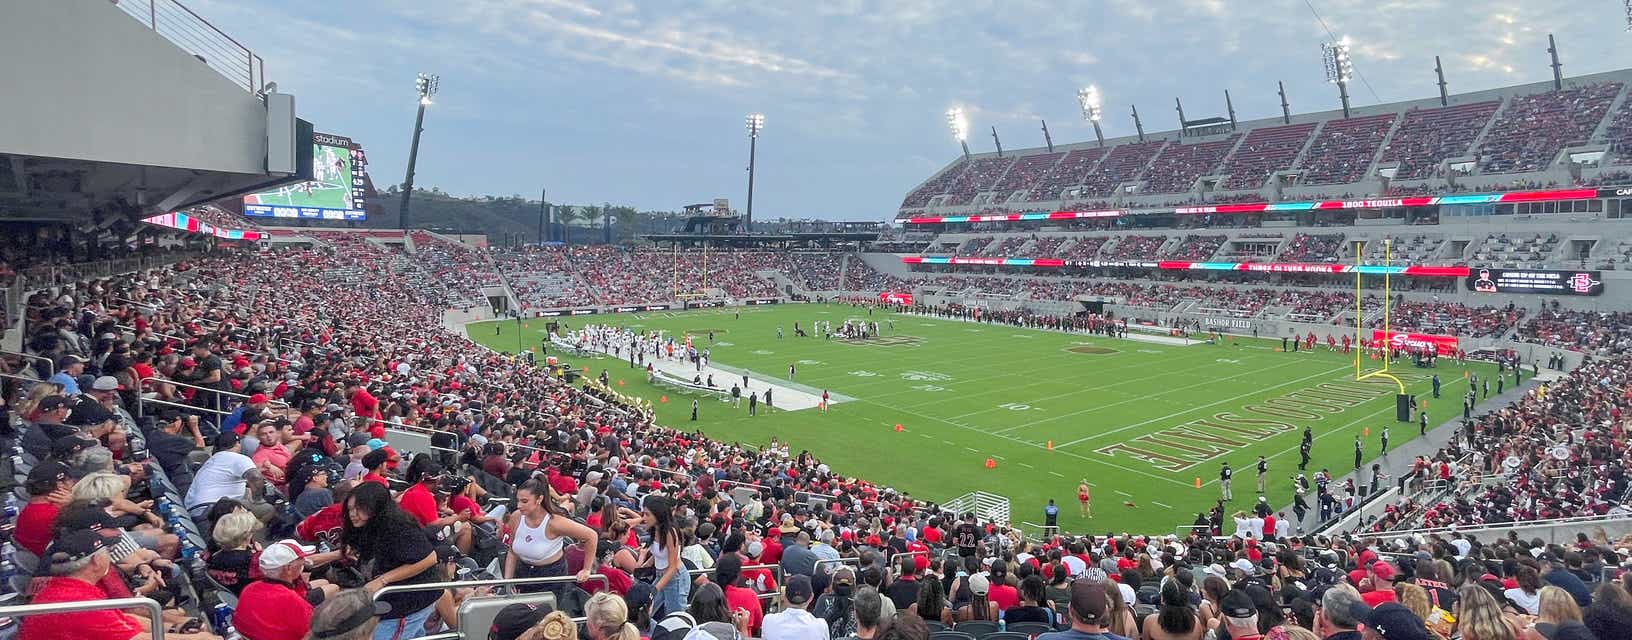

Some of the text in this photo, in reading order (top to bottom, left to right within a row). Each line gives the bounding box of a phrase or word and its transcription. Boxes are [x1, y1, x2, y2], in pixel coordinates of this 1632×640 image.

[313, 135, 349, 146] stadium
[1367, 199, 1403, 207] TEQUILA
[1231, 320, 1251, 328] FIELD
[1093, 412, 1298, 472] STATE
[960, 533, 976, 547] 22
[1415, 578, 1448, 589] AZTECS
